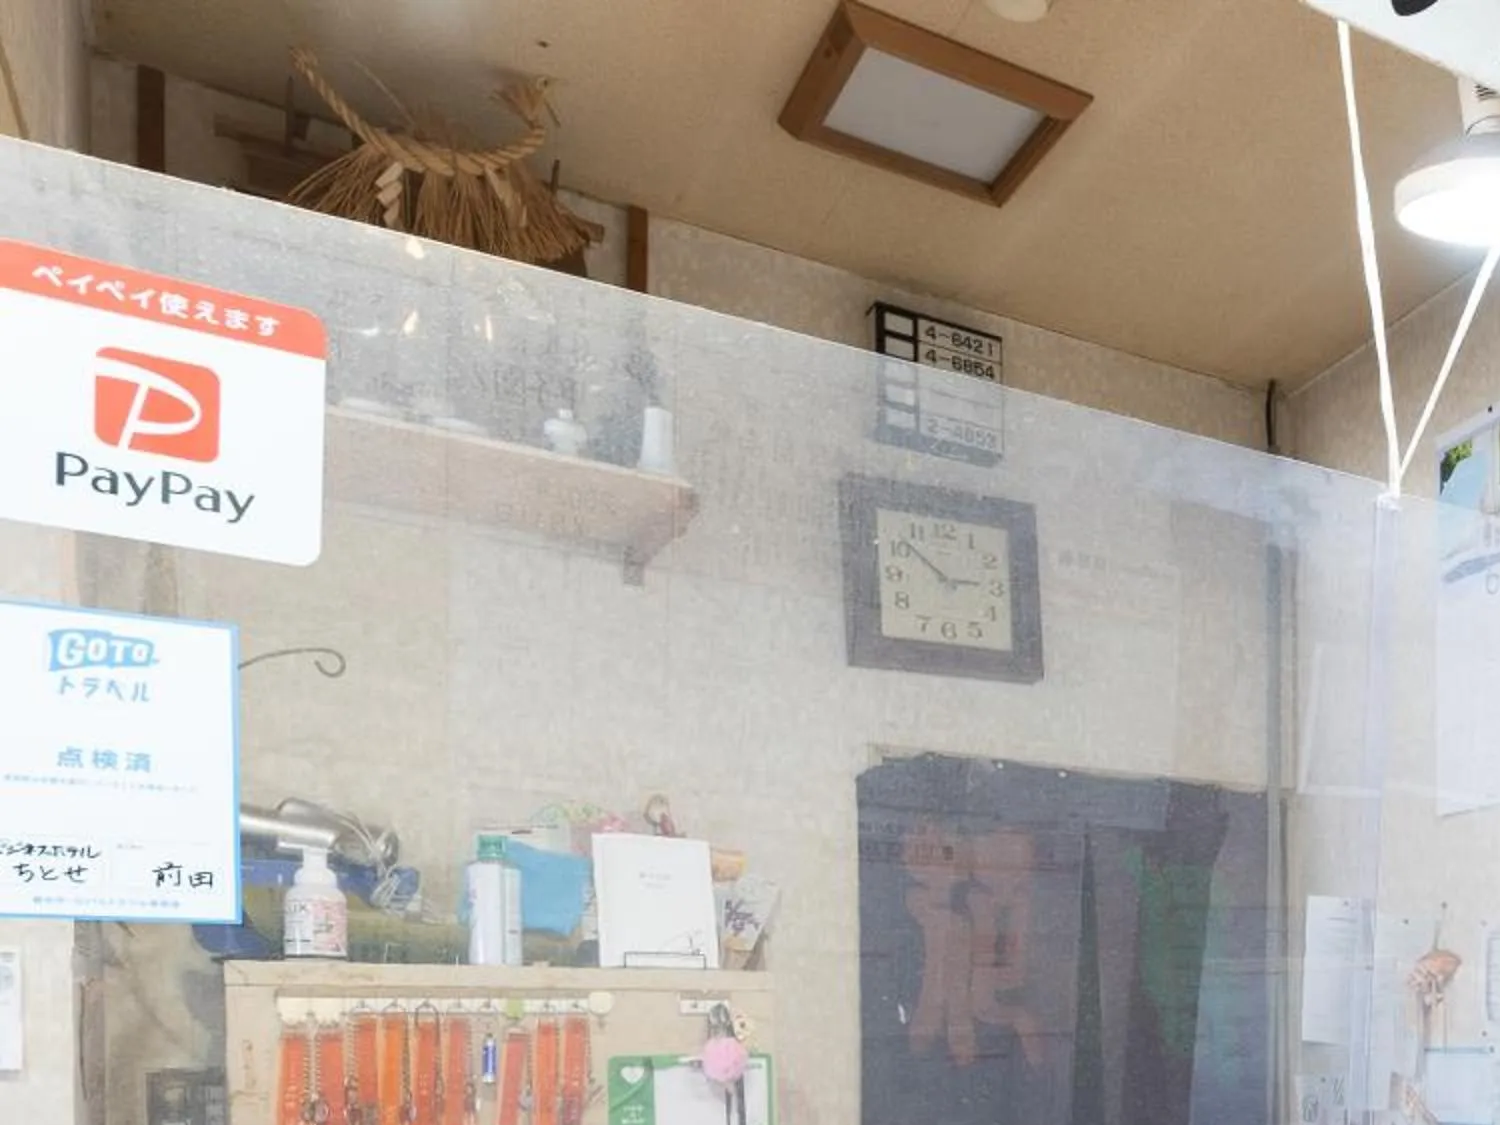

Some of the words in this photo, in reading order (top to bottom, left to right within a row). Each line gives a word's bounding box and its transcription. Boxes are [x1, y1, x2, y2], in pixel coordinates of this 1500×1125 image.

[32, 264, 281, 337] ペイペイ使えます
[55, 451, 255, 524] PayPay
[57, 746, 151, 773] 点検済
[12, 862, 89, 883] ちとせ
[152, 861, 214, 888] 前田
